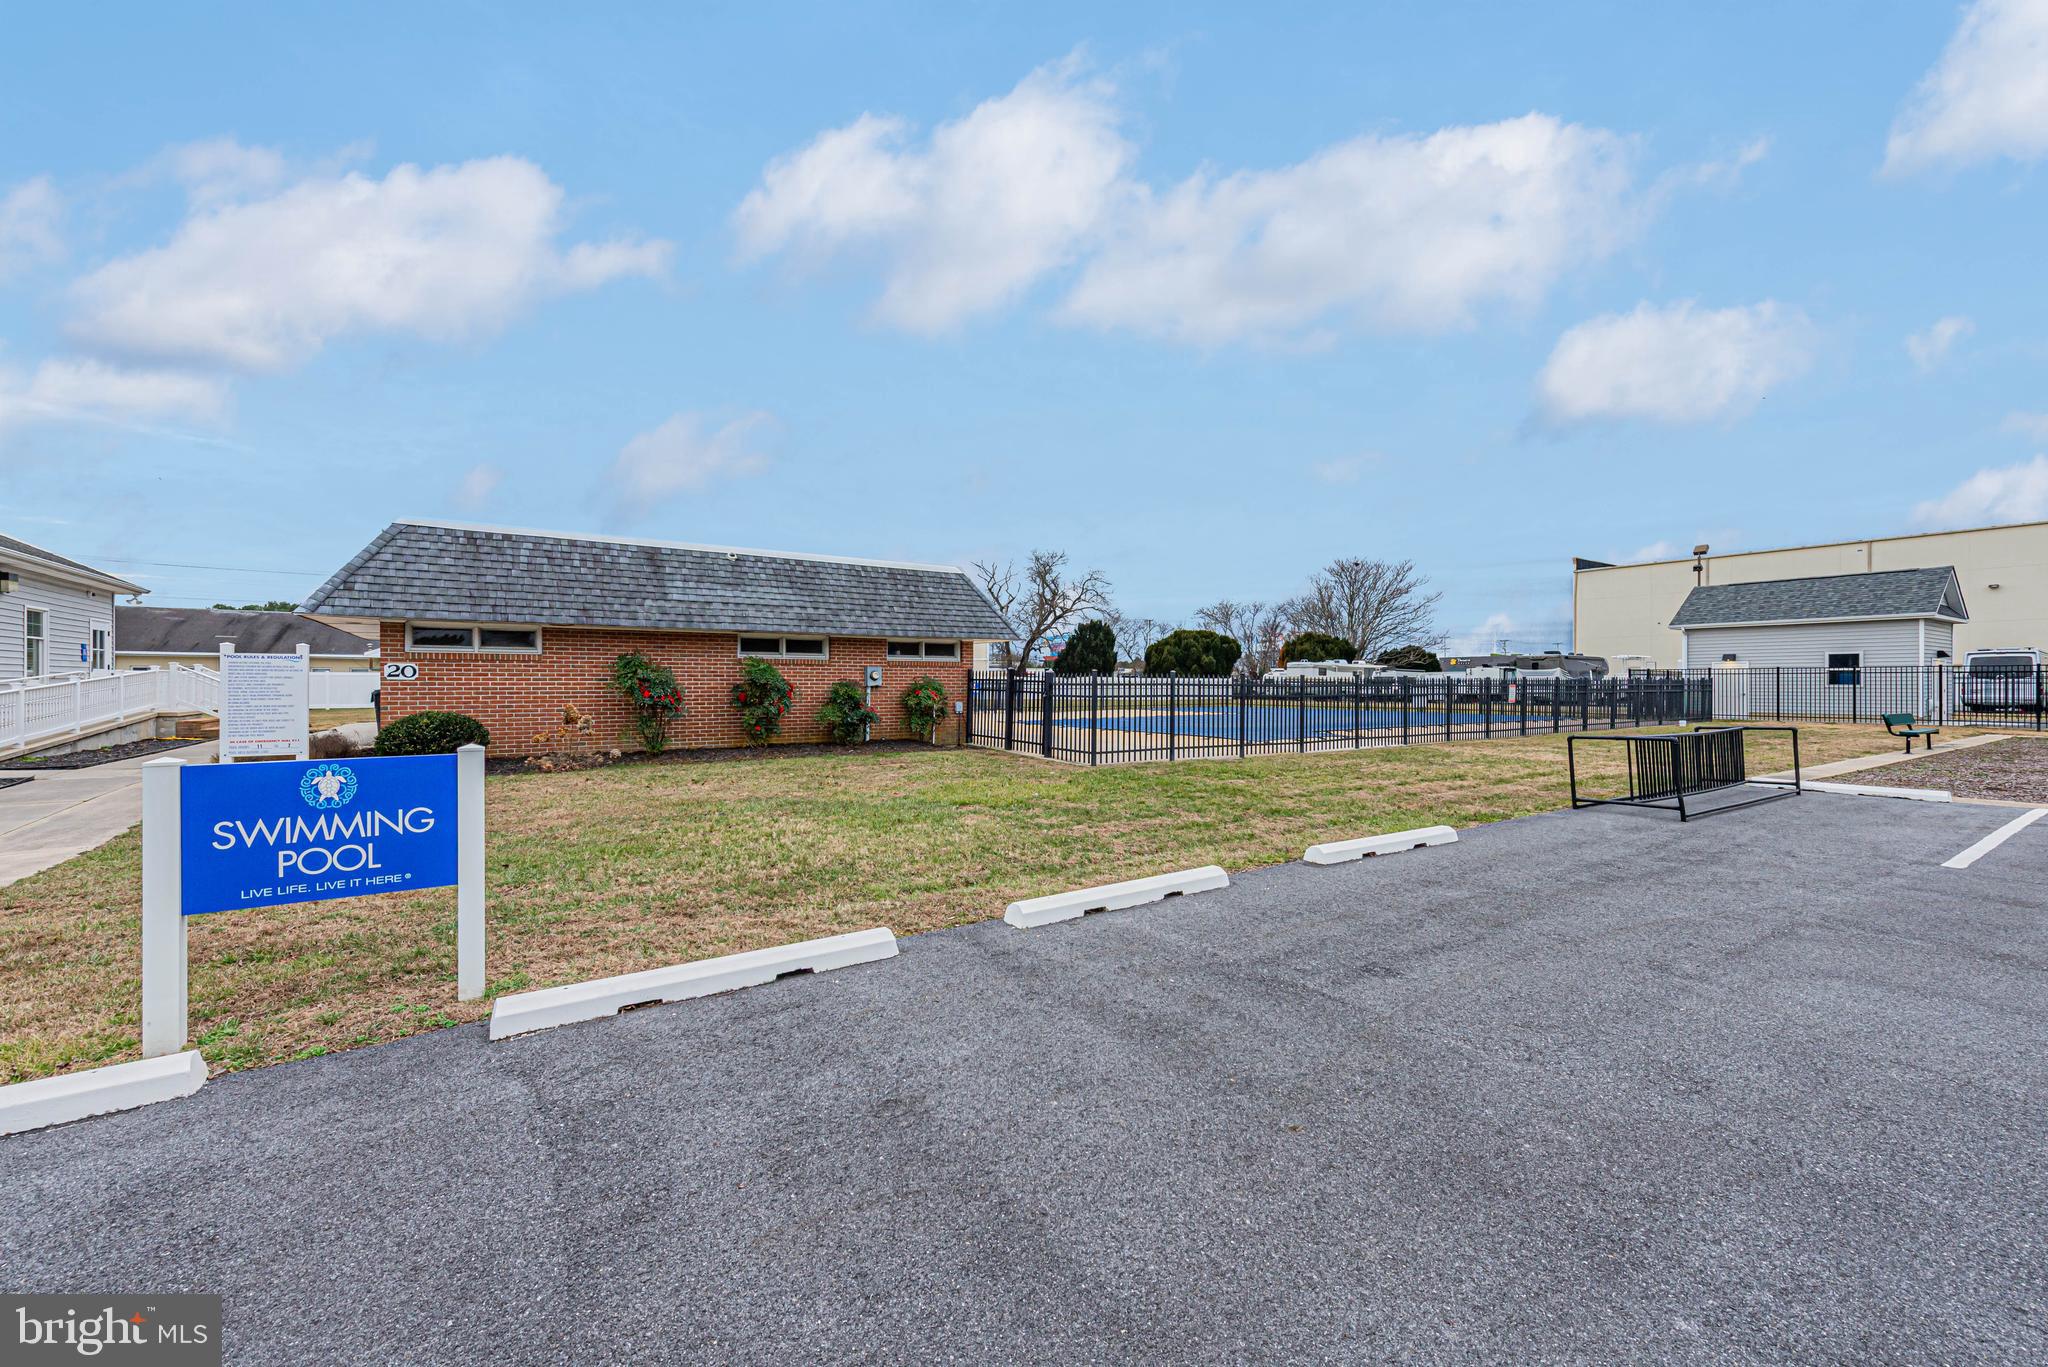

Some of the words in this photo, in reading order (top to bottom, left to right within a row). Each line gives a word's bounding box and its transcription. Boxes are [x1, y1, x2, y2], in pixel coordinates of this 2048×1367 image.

[386, 664, 417, 678] 20
[212, 806, 435, 850] SWIMMING
[278, 843, 382, 878] POOL
[240, 886, 273, 899] LIVE
[277, 883, 311, 895] LIFE.
[316, 879, 346, 892] LIVE
[350, 878, 361, 888] IT
[366, 875, 402, 886] HERE
